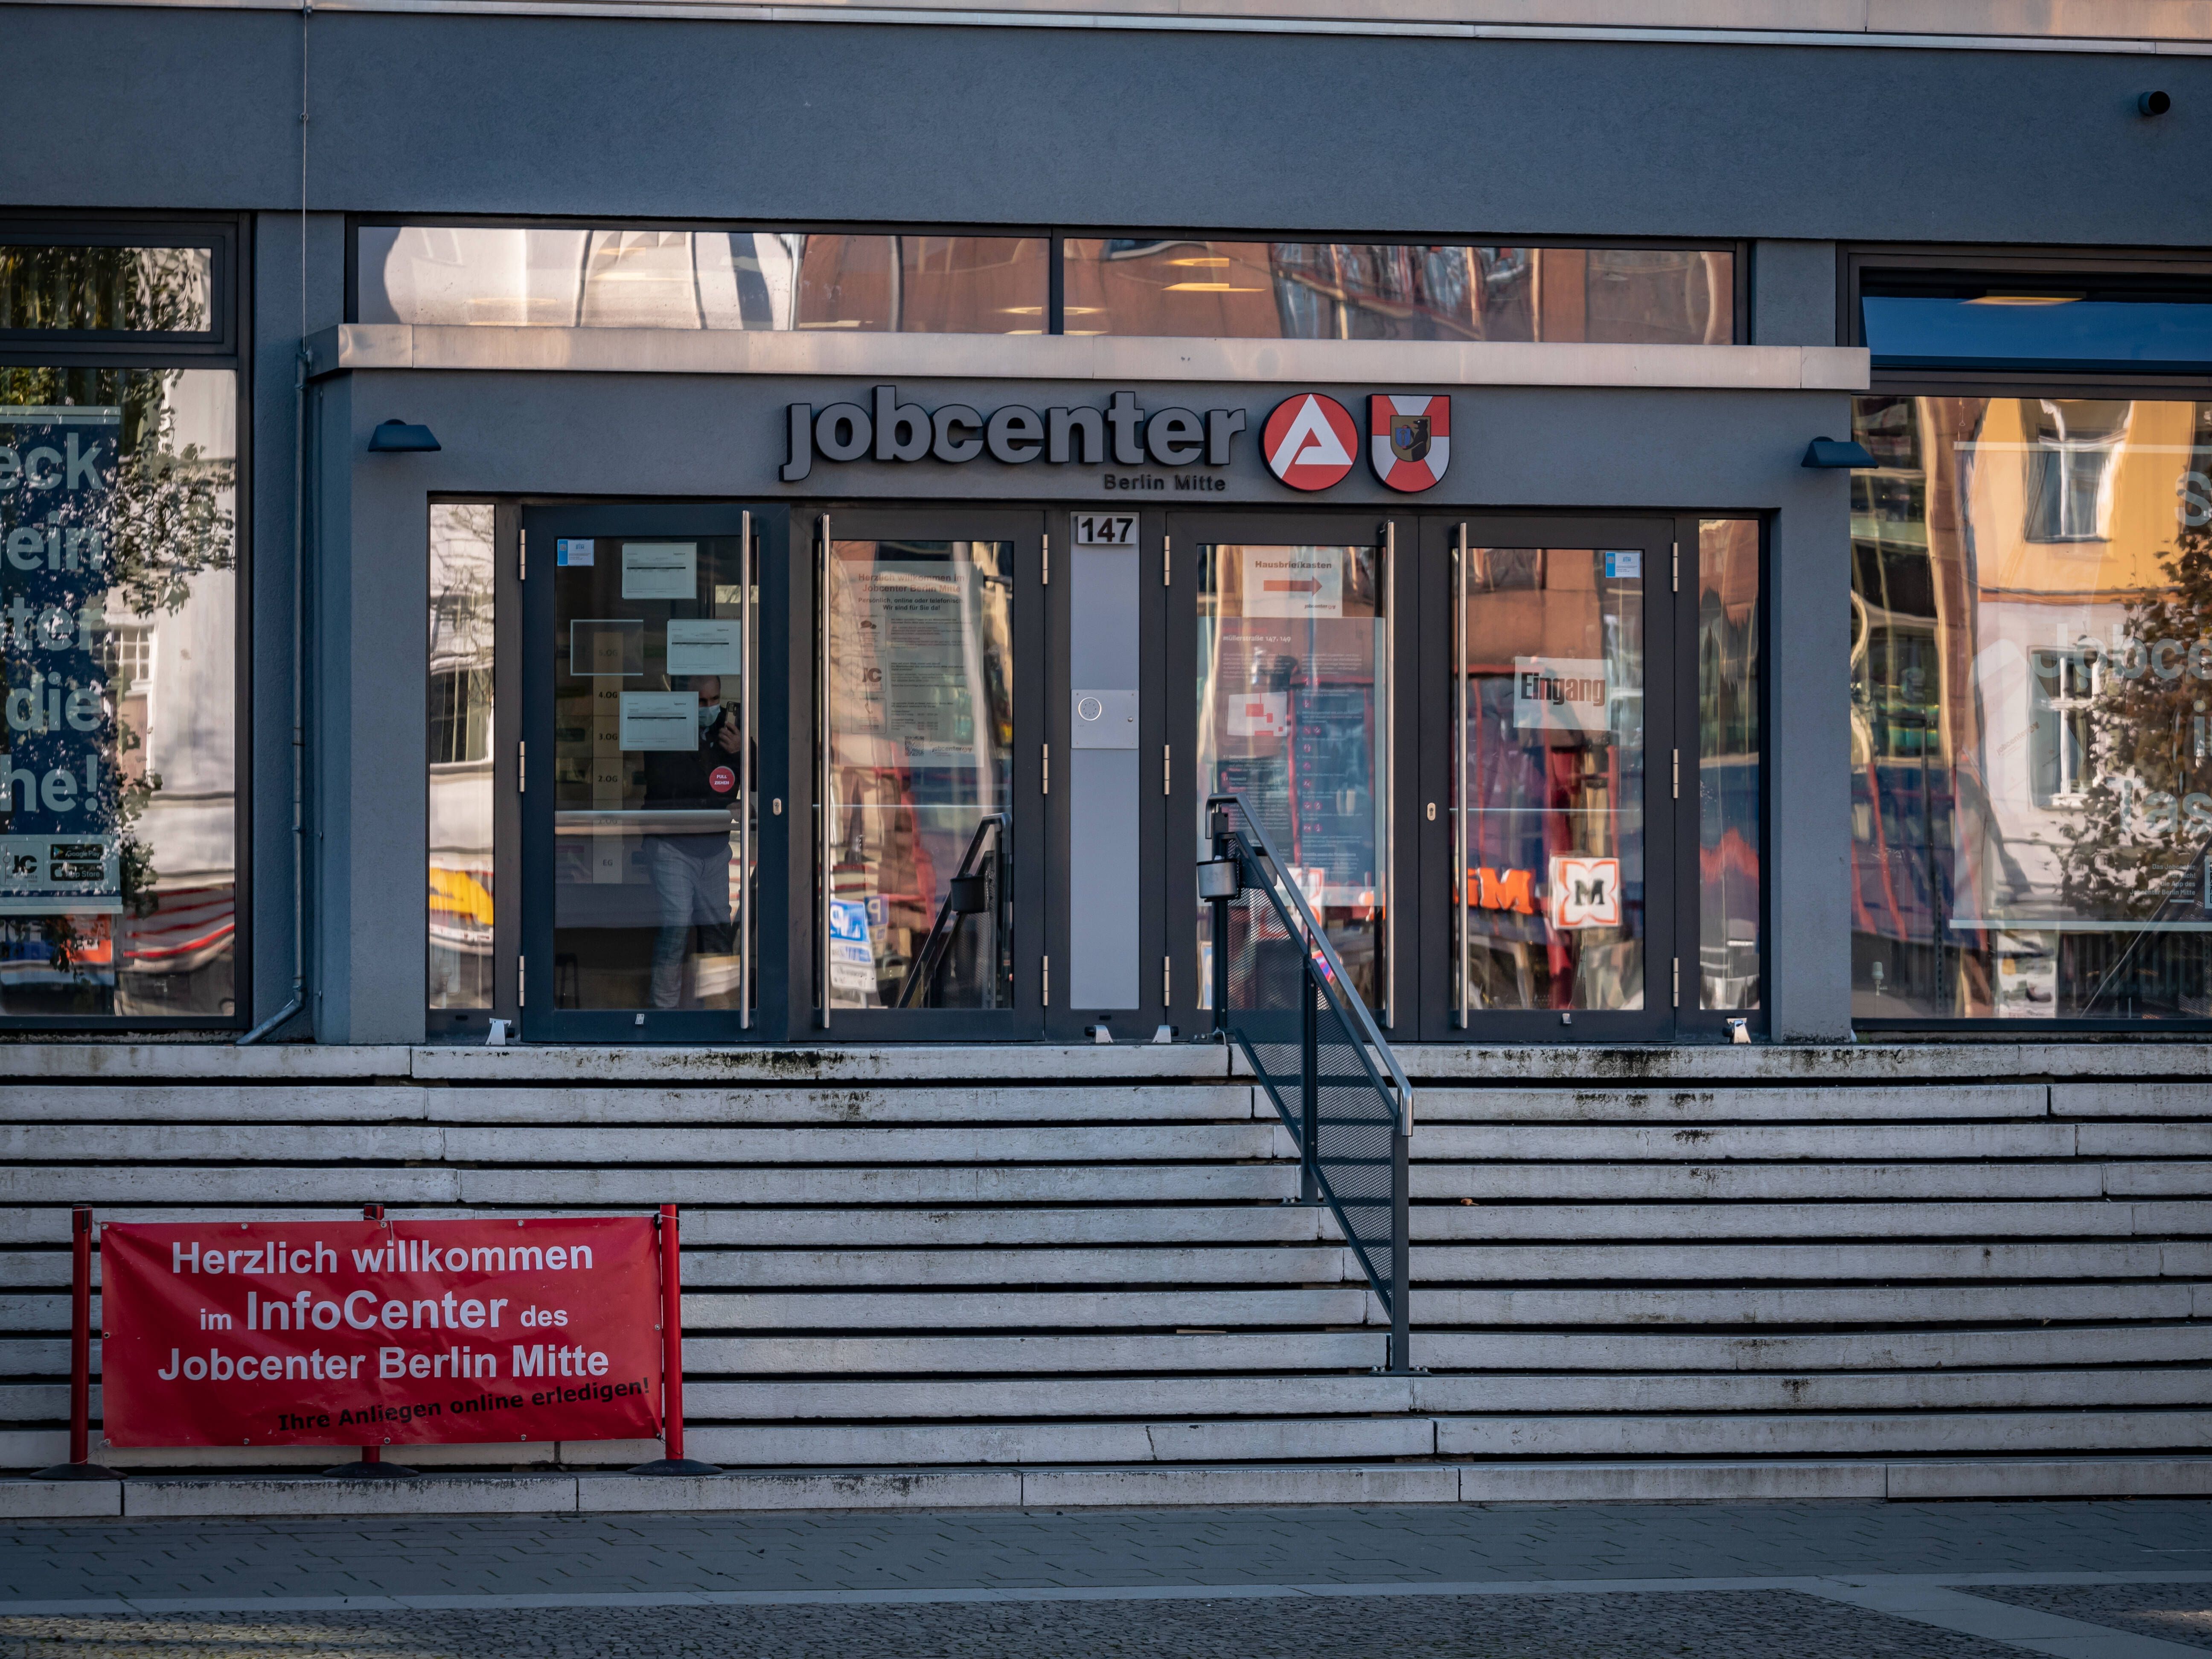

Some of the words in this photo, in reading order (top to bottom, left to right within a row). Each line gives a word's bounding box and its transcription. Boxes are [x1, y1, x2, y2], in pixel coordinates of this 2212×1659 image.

[778, 385, 1246, 482] jobcenter
[1104, 474, 1164, 490] Berlin
[1175, 474, 1225, 491] Mitte
[0, 510, 102, 570] ein
[1081, 518, 1133, 542] 147
[1255, 561, 1331, 569] Hausbriefkasten
[0, 597, 105, 650] ter
[6, 672, 103, 731] die
[1521, 672, 1605, 706] Eingang
[173, 1241, 337, 1274] Herzlich
[351, 1240, 593, 1273] willkommen
[201, 1308, 232, 1330] im
[247, 1289, 508, 1330] InfoCenter
[520, 1304, 568, 1327] des
[158, 1348, 366, 1380] Jobcenter
[379, 1345, 497, 1379] Berlin
[512, 1344, 609, 1377] Mitte
[278, 1413, 330, 1431] Ihre
[338, 1402, 441, 1426] Anliegen
[450, 1394, 524, 1414] online
[532, 1377, 649, 1406] erledigen!
